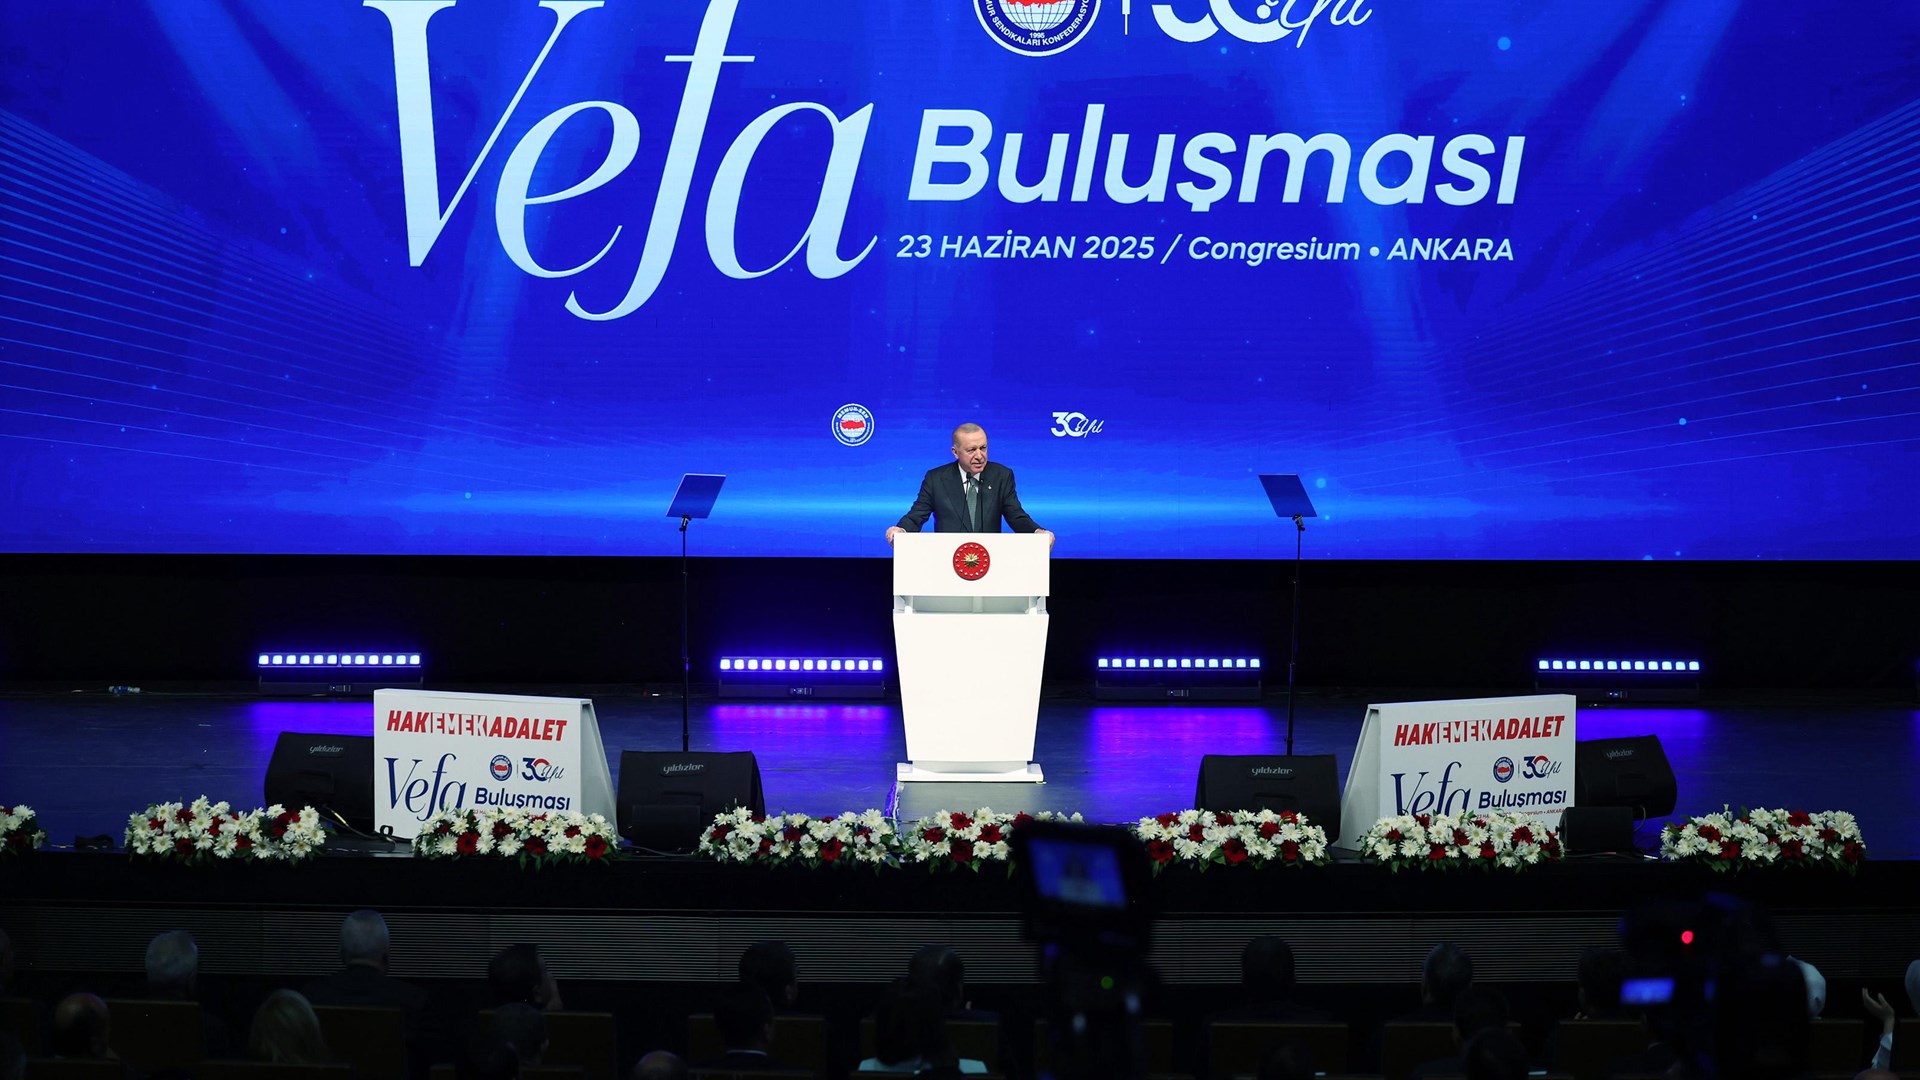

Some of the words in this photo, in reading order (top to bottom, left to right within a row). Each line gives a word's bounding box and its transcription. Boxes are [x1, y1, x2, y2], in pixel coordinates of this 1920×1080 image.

[363, 0, 878, 321] Vefa
[907, 103, 1526, 212] Buluşması
[896, 234, 933, 258] 23
[939, 229, 1076, 259] HAZİRAN
[1082, 235, 1155, 260] 2025
[1188, 234, 1361, 267] Congresium
[1386, 237, 1514, 261] ANKARA
[383, 753, 468, 822] Vefa
[474, 787, 571, 811] Buluşması
[1478, 789, 1567, 809] Buluşması
